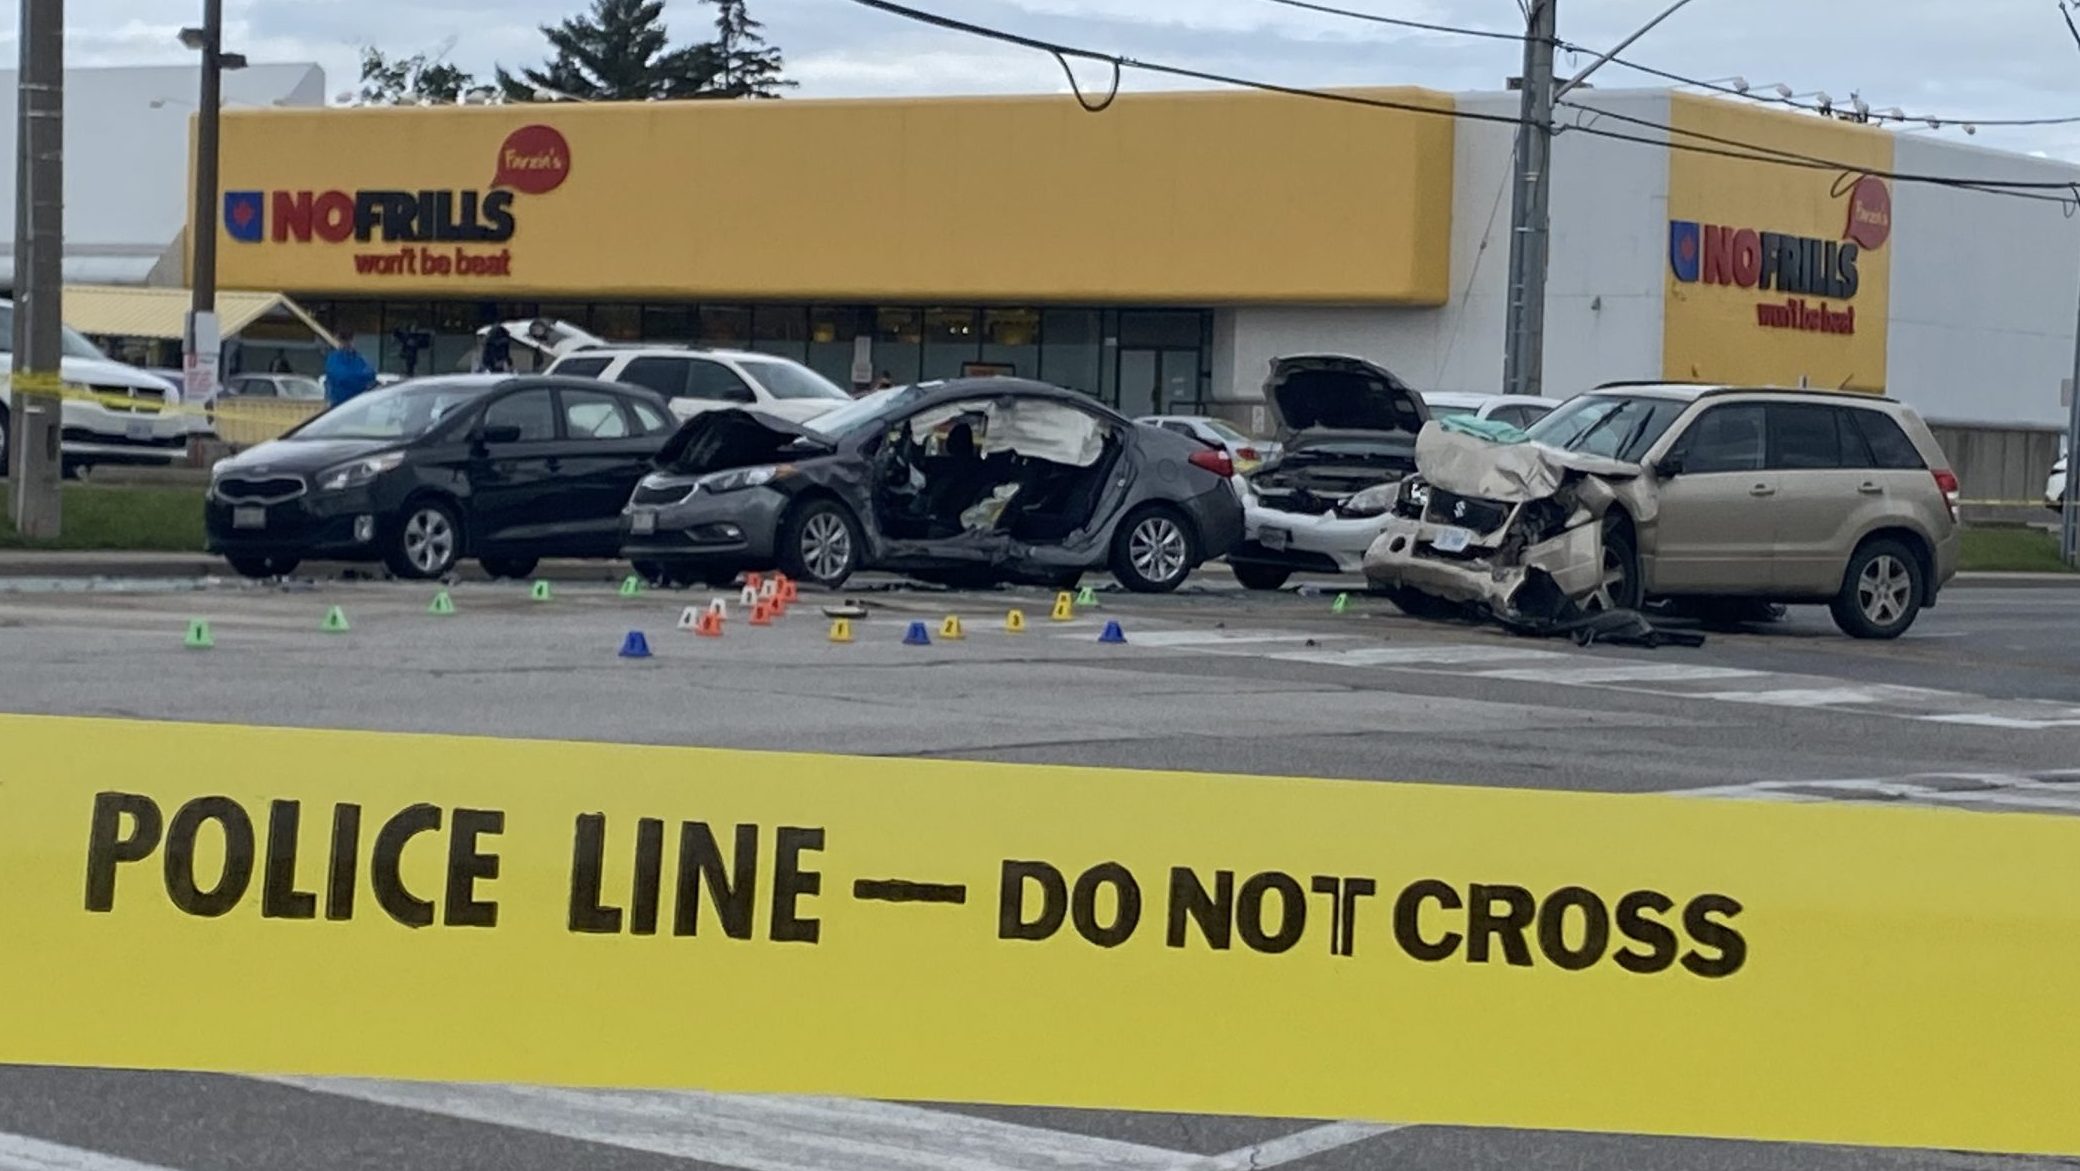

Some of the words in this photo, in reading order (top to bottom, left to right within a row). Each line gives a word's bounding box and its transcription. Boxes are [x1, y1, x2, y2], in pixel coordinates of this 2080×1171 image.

[354, 245, 416, 276] won't
[420, 246, 451, 276] be
[455, 246, 512, 277] beat
[84, 791, 504, 928] POLICE
[567, 812, 825, 944] LINE
[997, 860, 1141, 948] DO
[1166, 866, 1376, 957] NOT
[1393, 879, 1748, 978] CROSS
